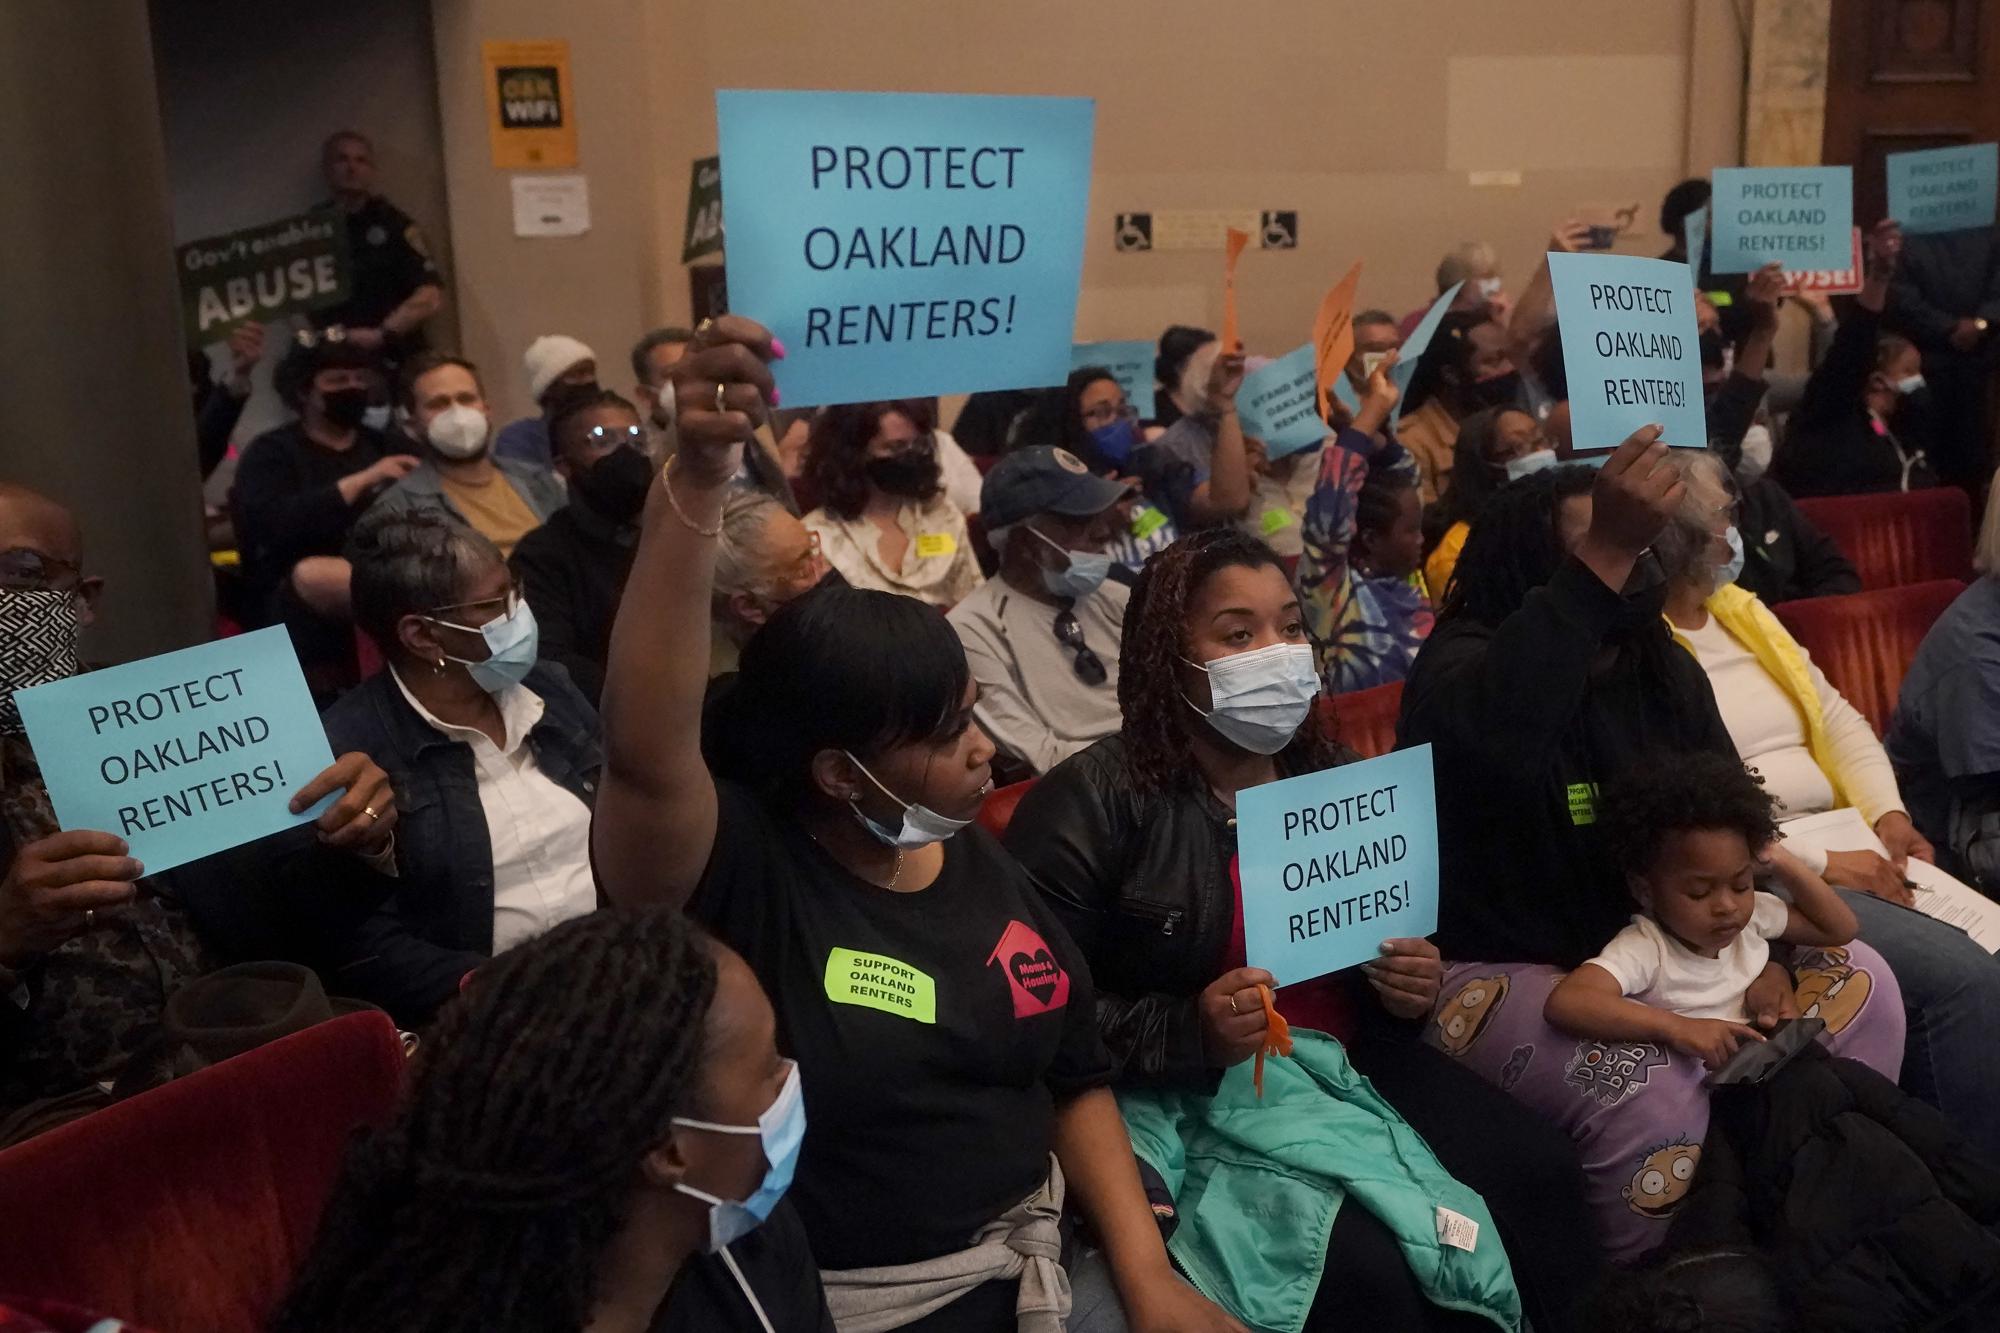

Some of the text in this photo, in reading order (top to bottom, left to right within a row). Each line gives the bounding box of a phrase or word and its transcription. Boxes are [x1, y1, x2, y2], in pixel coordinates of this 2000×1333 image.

[811, 144, 1025, 191] PROTECT
[1742, 182, 1823, 199] PROTECT
[1738, 209, 1826, 225] OAKLAND
[803, 223, 1026, 273] OAKLAND
[1738, 234, 1825, 251] RENTERS!
[198, 254, 338, 331] ABUSE
[1590, 283, 1673, 315] PROTECT
[805, 293, 1018, 349] RENTERS!
[1596, 331, 1683, 361] OAKLAND
[1250, 383, 1292, 409] STAND
[1265, 389, 1316, 417] OAKLAN
[1604, 378, 1685, 408] RENTERS!
[1273, 406, 1315, 431] RENTE
[87, 668, 244, 736] PROTECT
[100, 715, 270, 786] OAKLAND
[117, 760, 288, 837] RENTERS!
[1284, 785, 1399, 841] PROTECT
[1282, 834, 1408, 892] OAKLAND
[1288, 880, 1411, 944] RENTERS!
[849, 971, 916, 995] OAKLAND
[853, 957, 915, 981] SUPPORT
[1019, 961, 1046, 975] Moms
[850, 984, 913, 1009] RENTERS
[1595, 1053, 1619, 1076] be
